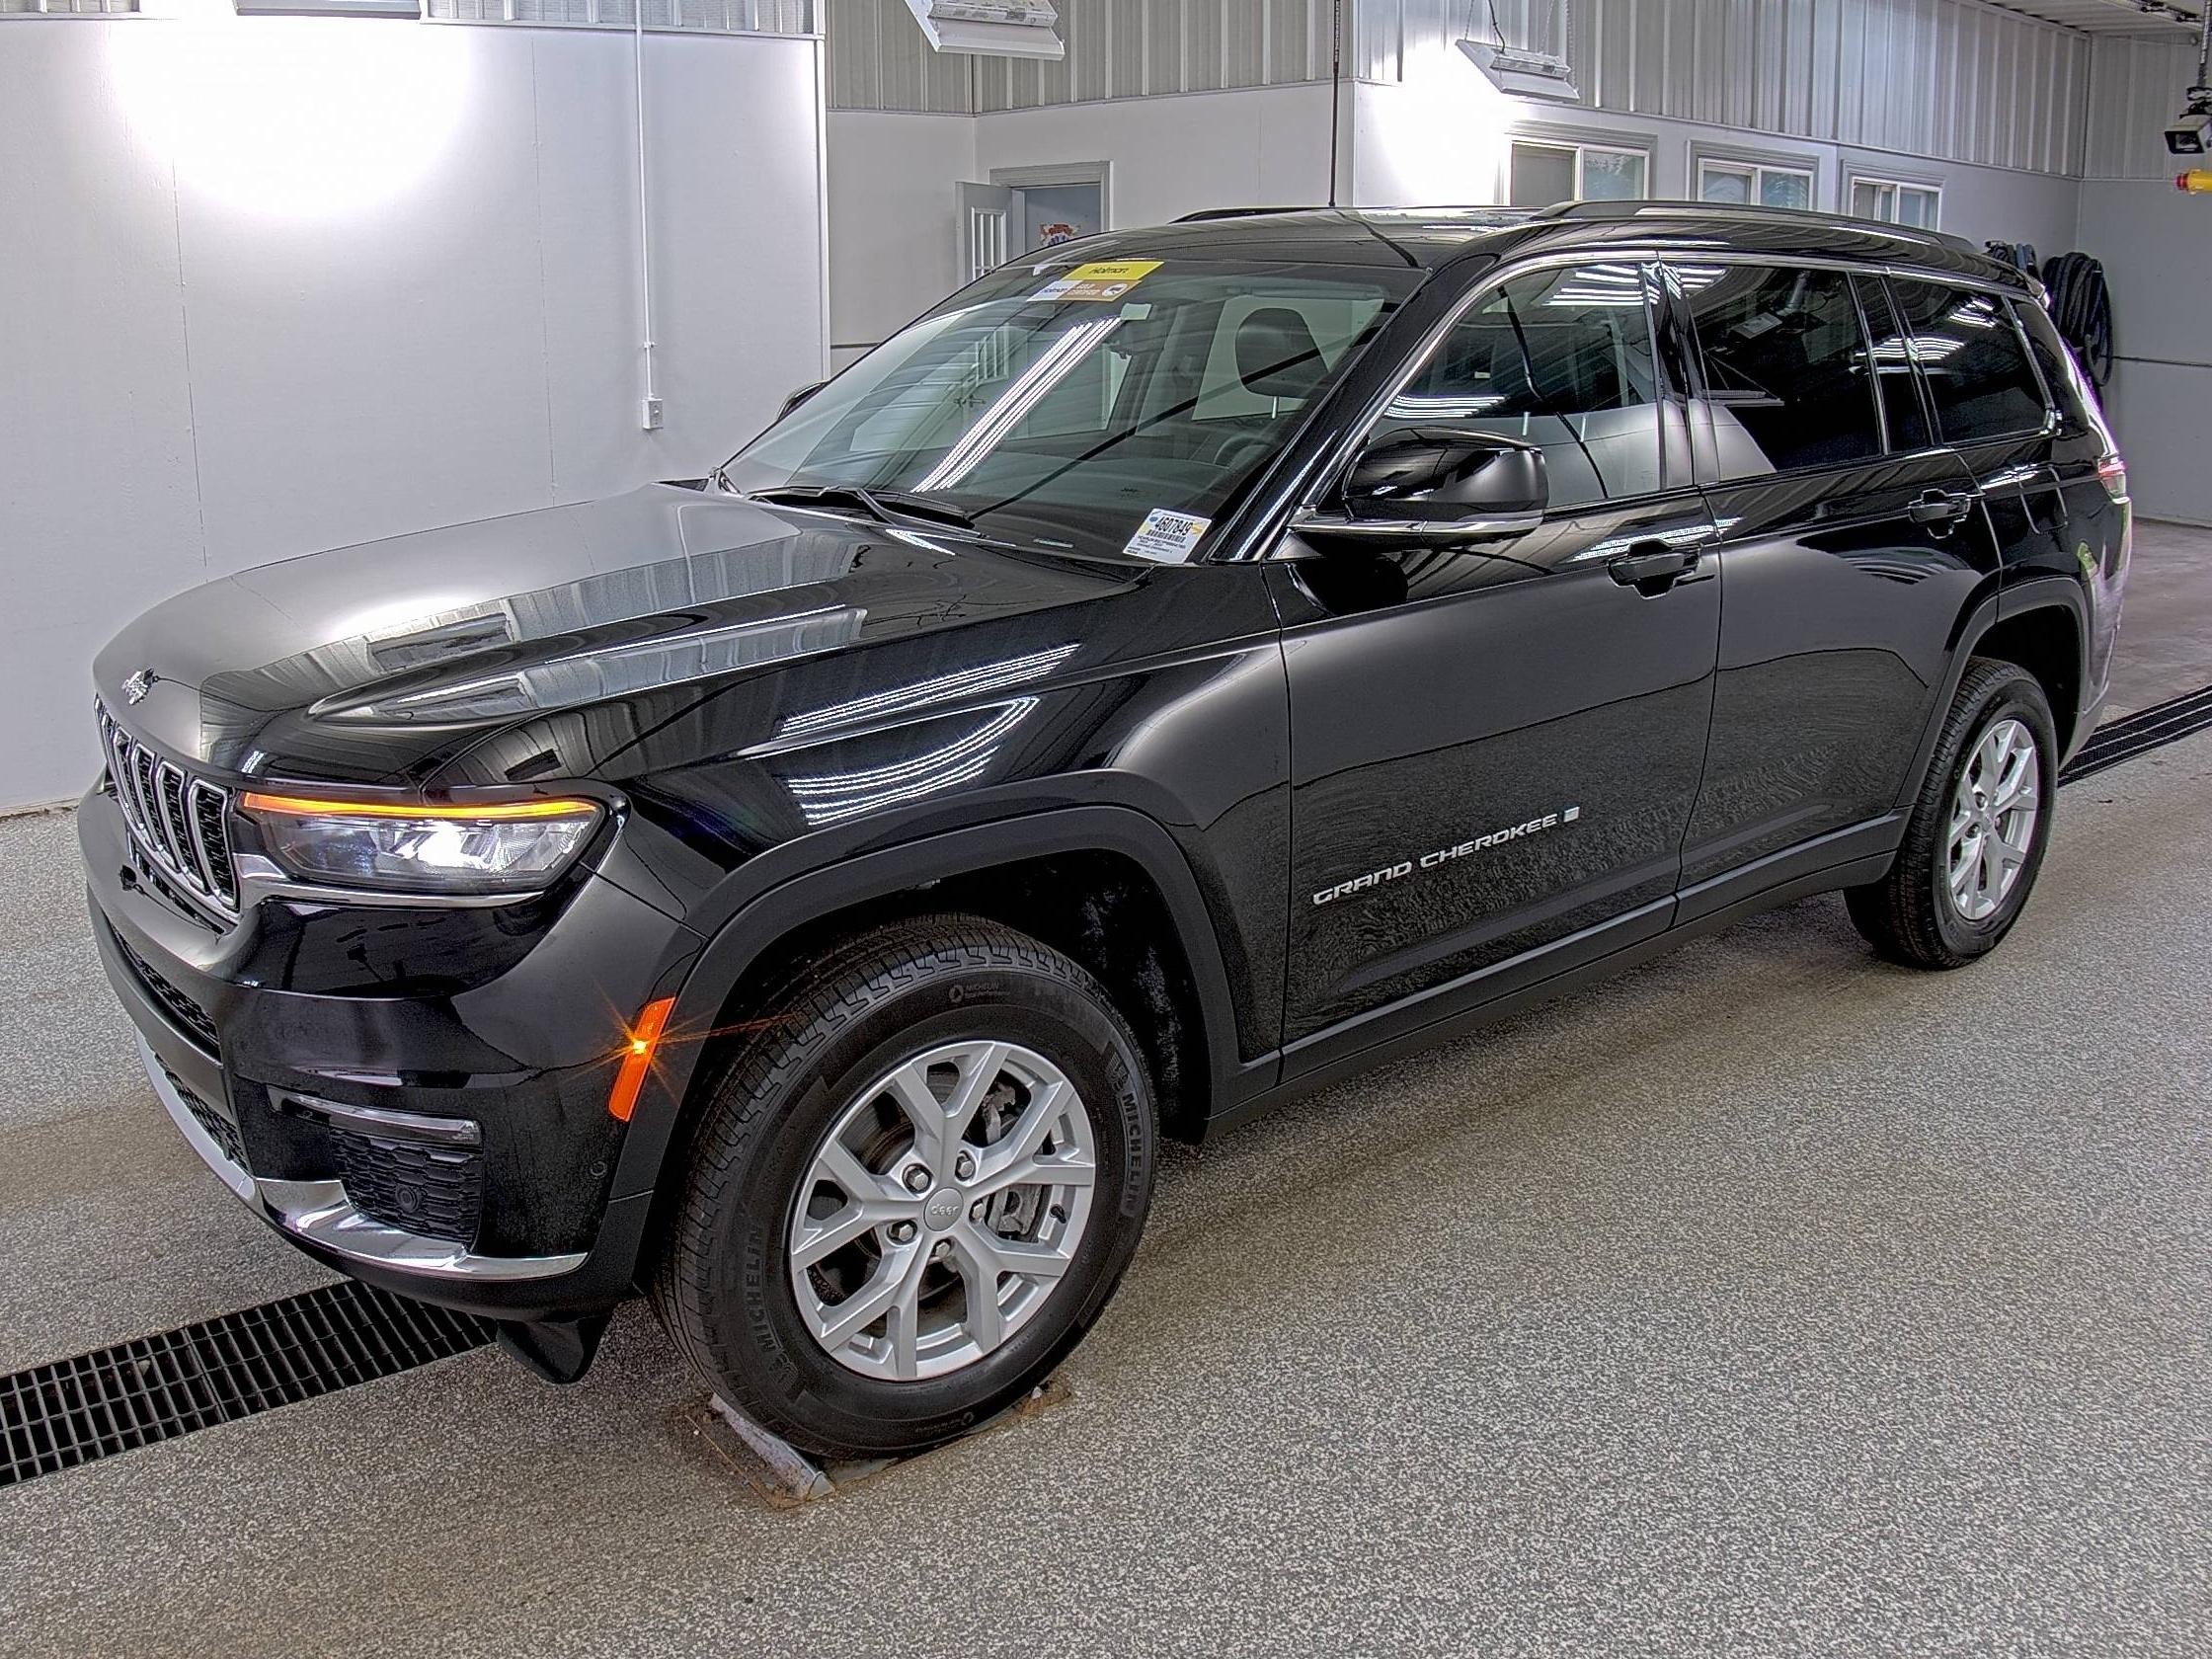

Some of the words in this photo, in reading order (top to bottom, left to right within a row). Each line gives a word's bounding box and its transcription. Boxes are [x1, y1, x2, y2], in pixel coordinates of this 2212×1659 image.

[1155, 515, 1194, 536] 4607849
[1312, 861, 1412, 905] GRAND
[1419, 813, 1557, 869] CHEROKEE
[1122, 1091, 1143, 1212] MICHELIN
[747, 1224, 776, 1352] MICHELIN
